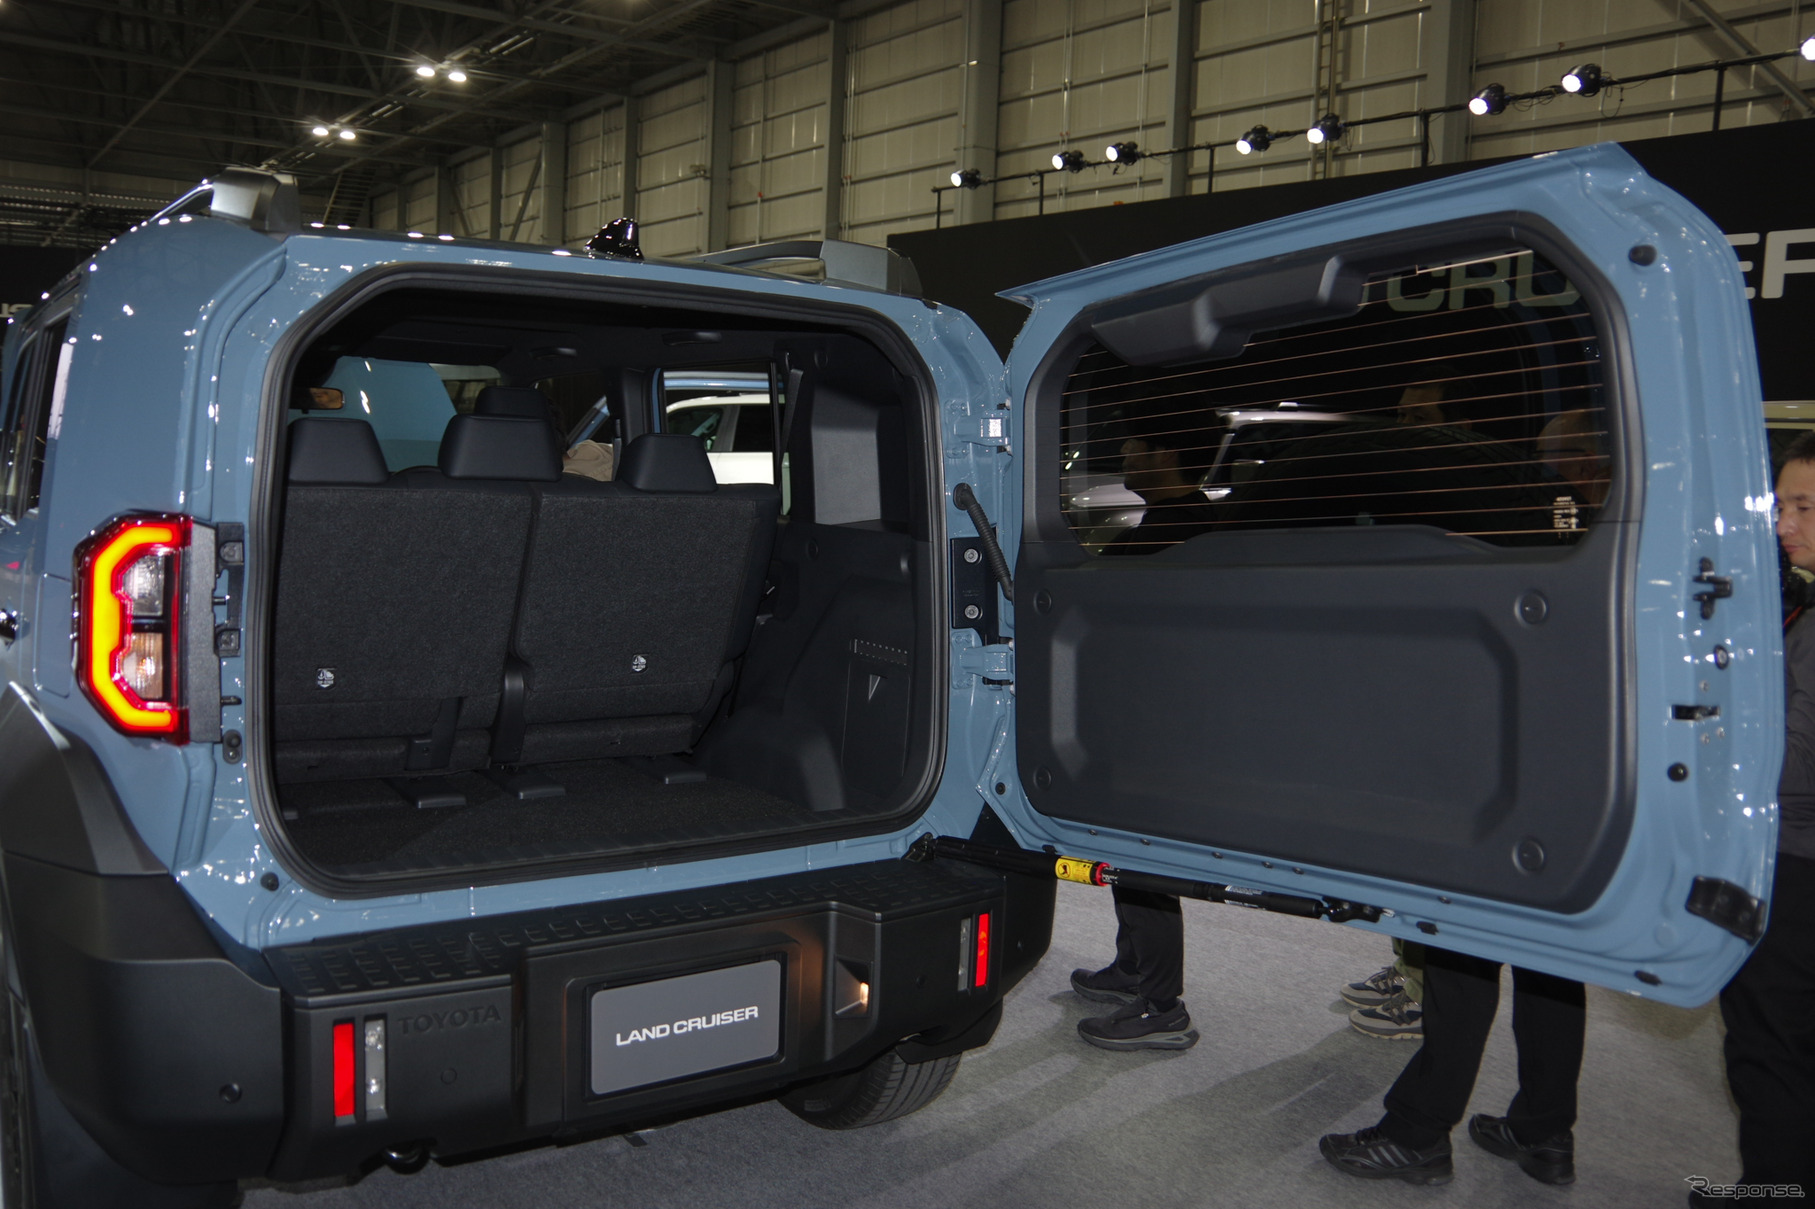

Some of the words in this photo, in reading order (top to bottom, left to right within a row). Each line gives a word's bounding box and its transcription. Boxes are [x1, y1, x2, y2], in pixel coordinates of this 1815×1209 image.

[398, 1004, 502, 1035] TOYOTA
[616, 1023, 671, 1046] LAND
[673, 1005, 759, 1035] CRUISER
